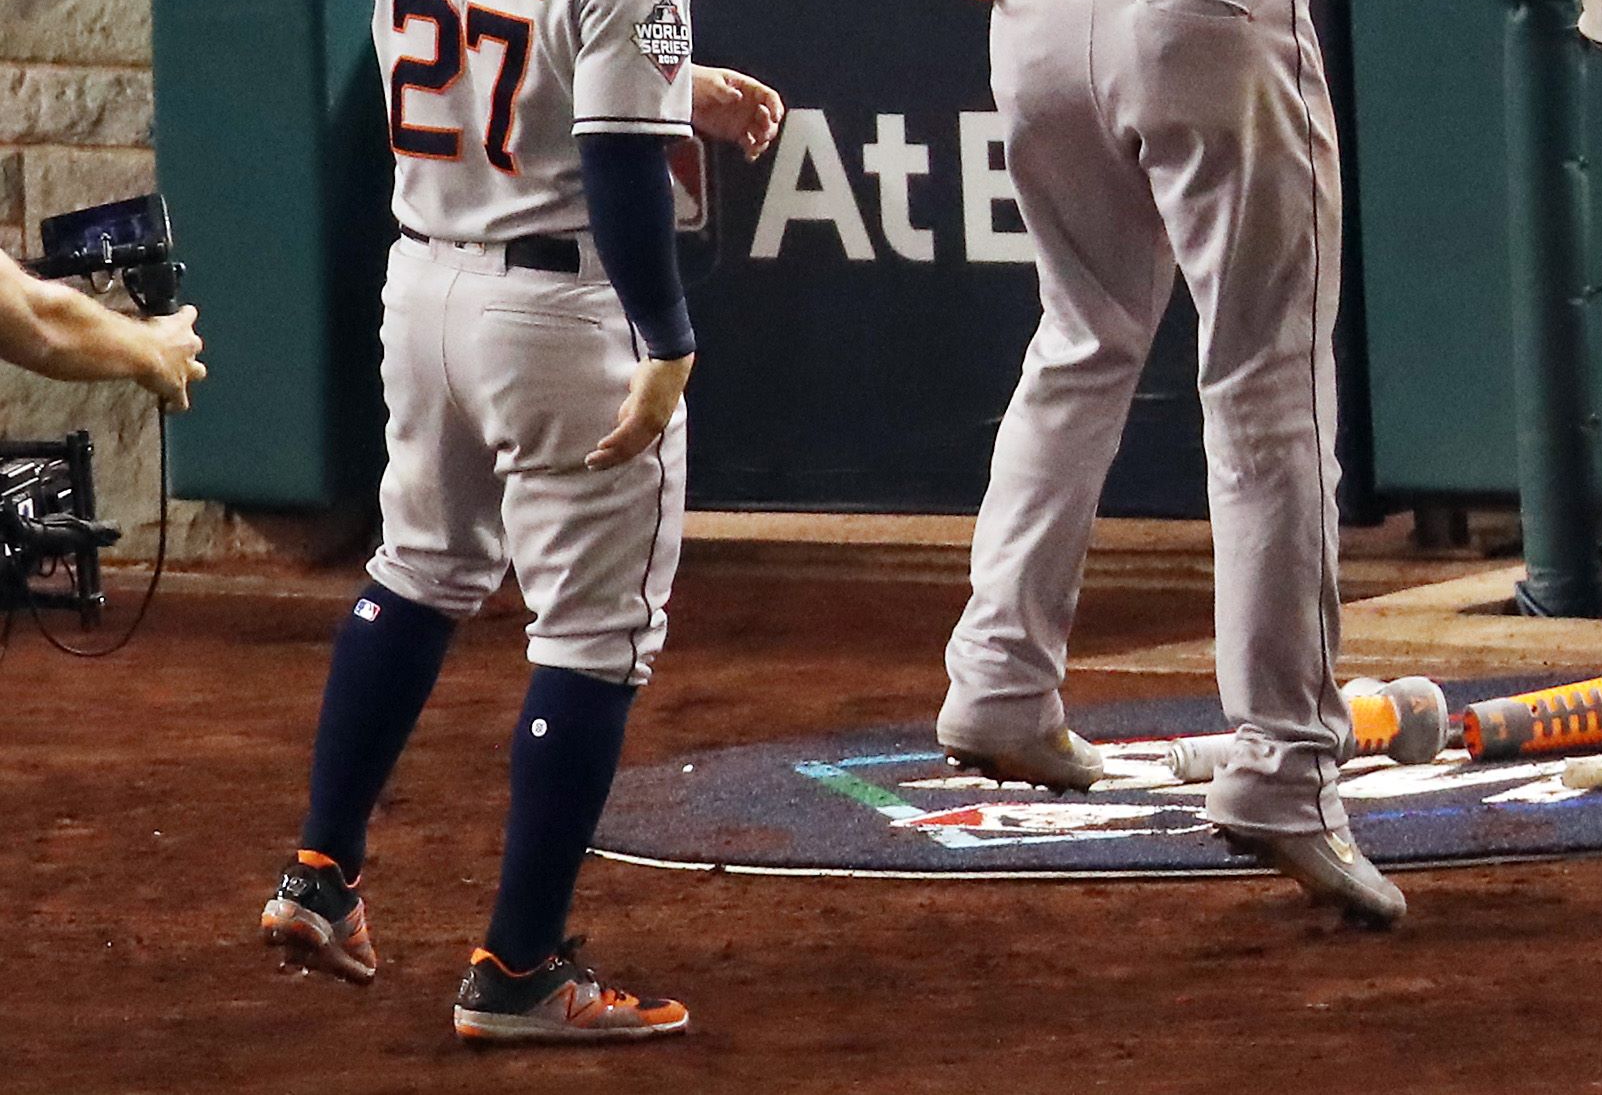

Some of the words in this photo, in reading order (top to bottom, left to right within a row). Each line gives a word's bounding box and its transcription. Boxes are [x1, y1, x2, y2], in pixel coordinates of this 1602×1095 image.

[634, 24, 689, 41] WORLD
[639, 39, 690, 55] SERIES
[658, 54, 680, 65] 2019
[750, 108, 934, 262] At
